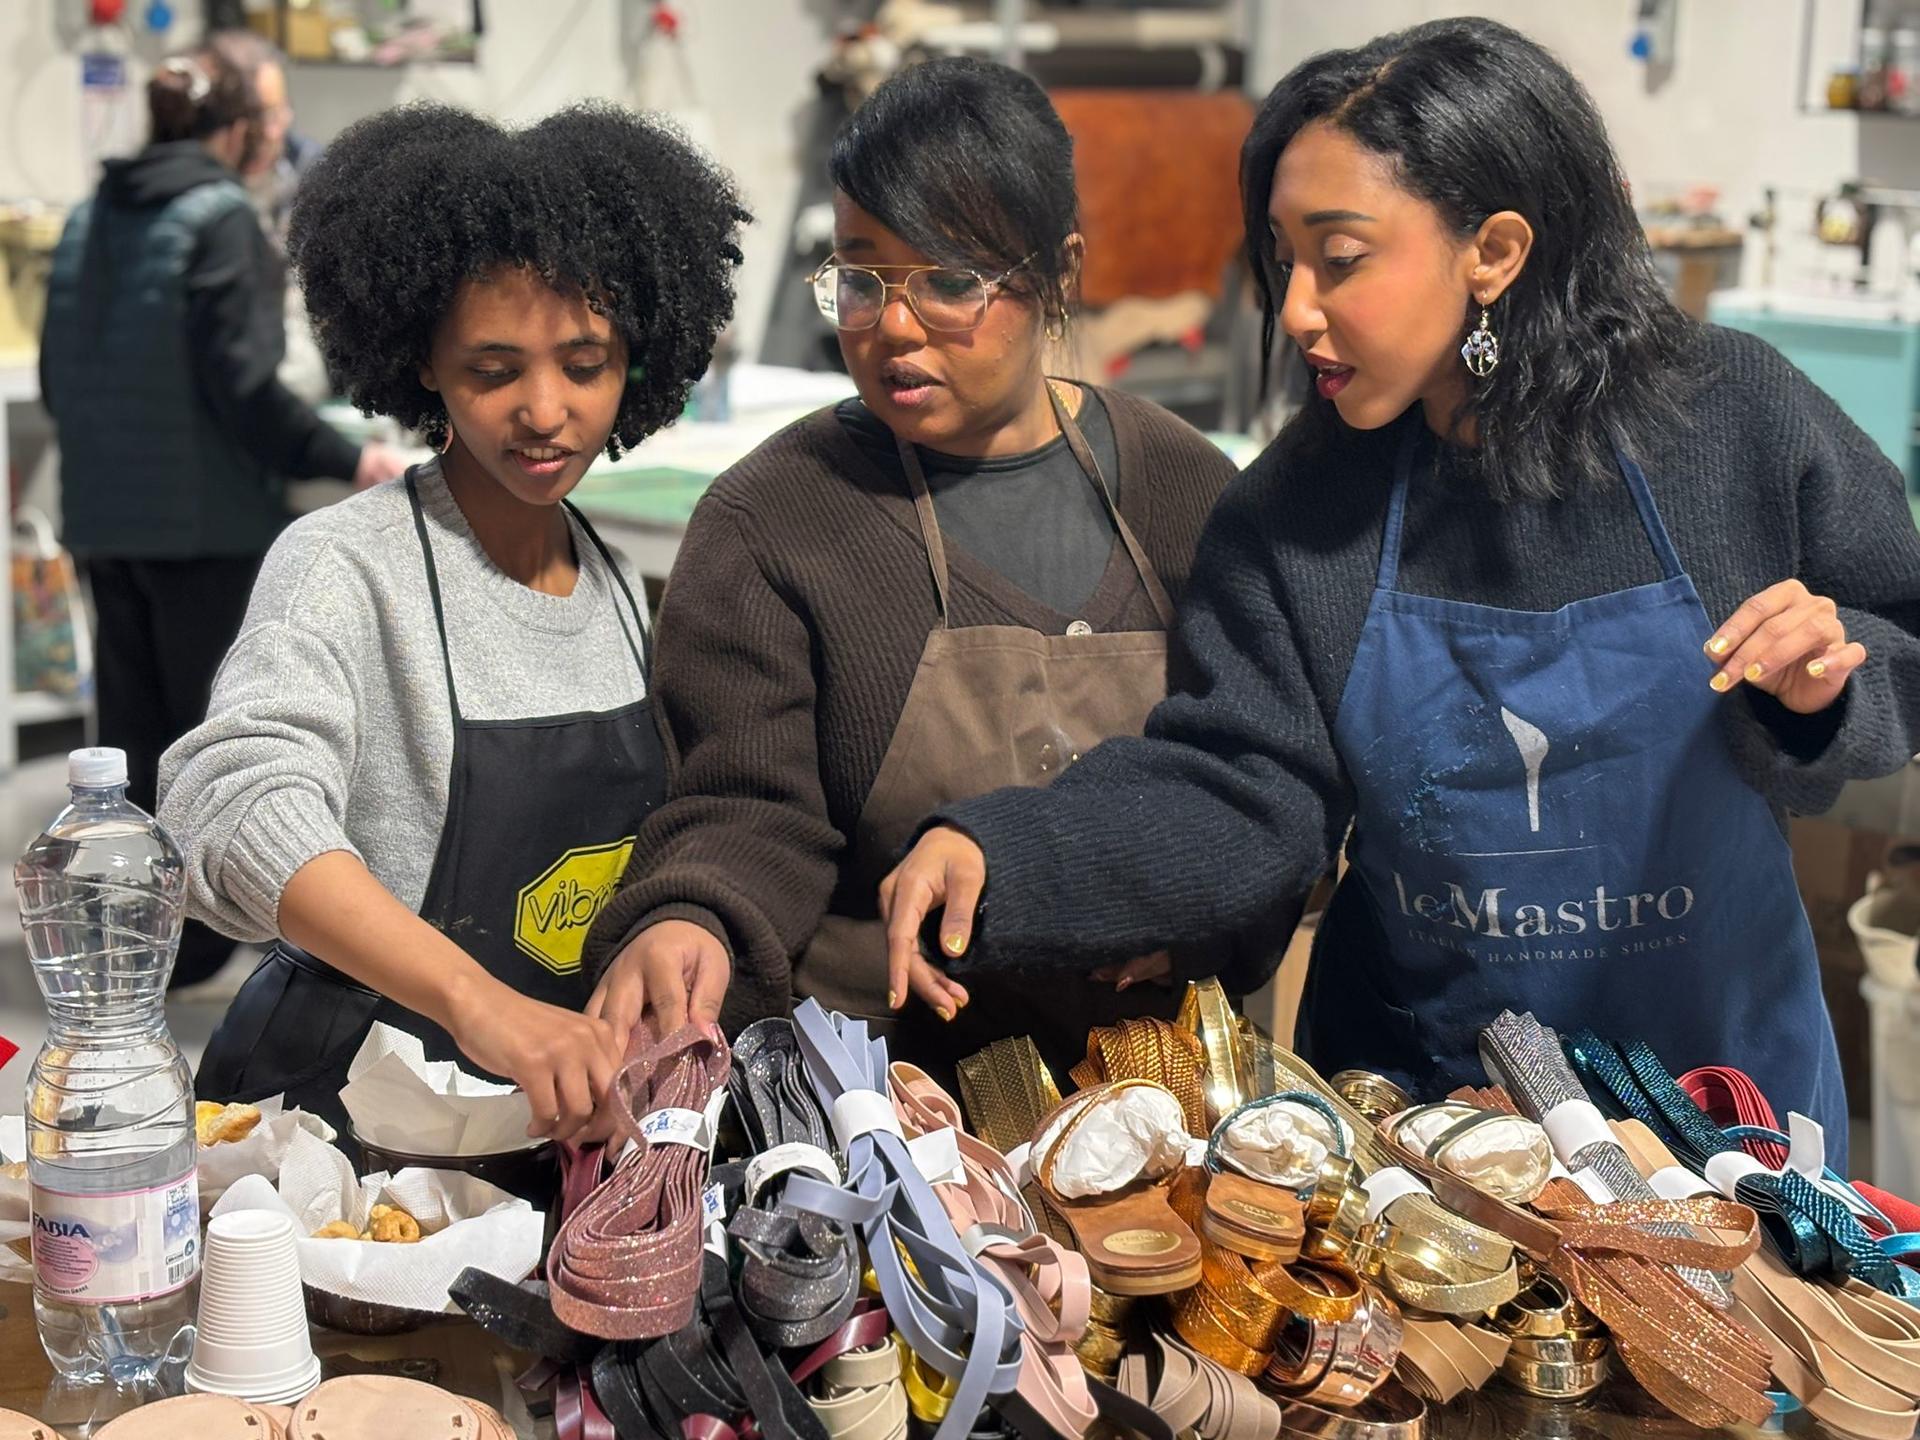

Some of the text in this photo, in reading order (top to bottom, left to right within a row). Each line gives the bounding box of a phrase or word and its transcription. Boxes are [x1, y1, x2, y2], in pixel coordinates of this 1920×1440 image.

[1487, 946, 1610, 963] HANDMADE
[1620, 933, 1689, 955] SHOES
[32, 1210, 91, 1239] FABIA
